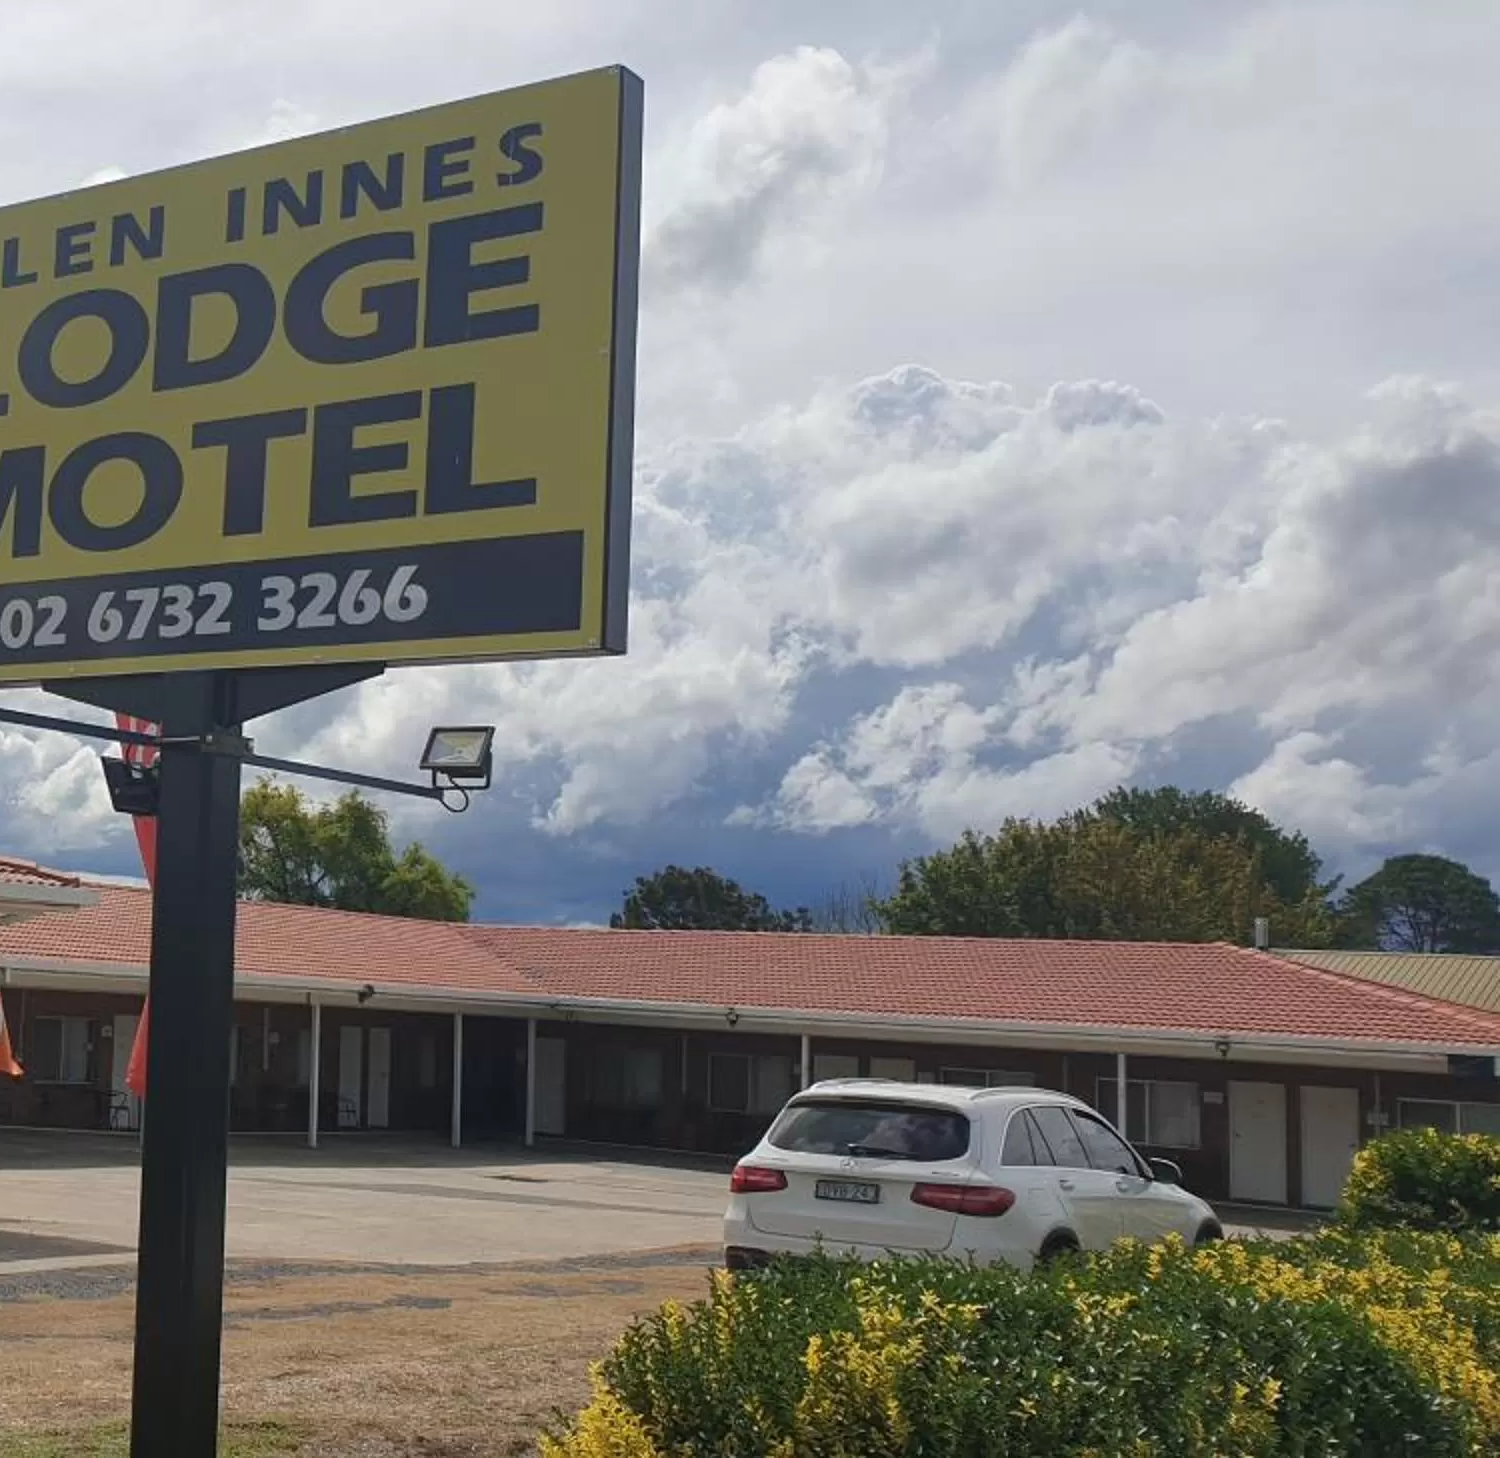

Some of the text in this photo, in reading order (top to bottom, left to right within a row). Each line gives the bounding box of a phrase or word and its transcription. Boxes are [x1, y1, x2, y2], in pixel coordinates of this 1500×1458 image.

[225, 122, 545, 243] INNES
[0, 564, 429, 649] 02 6732 3266
